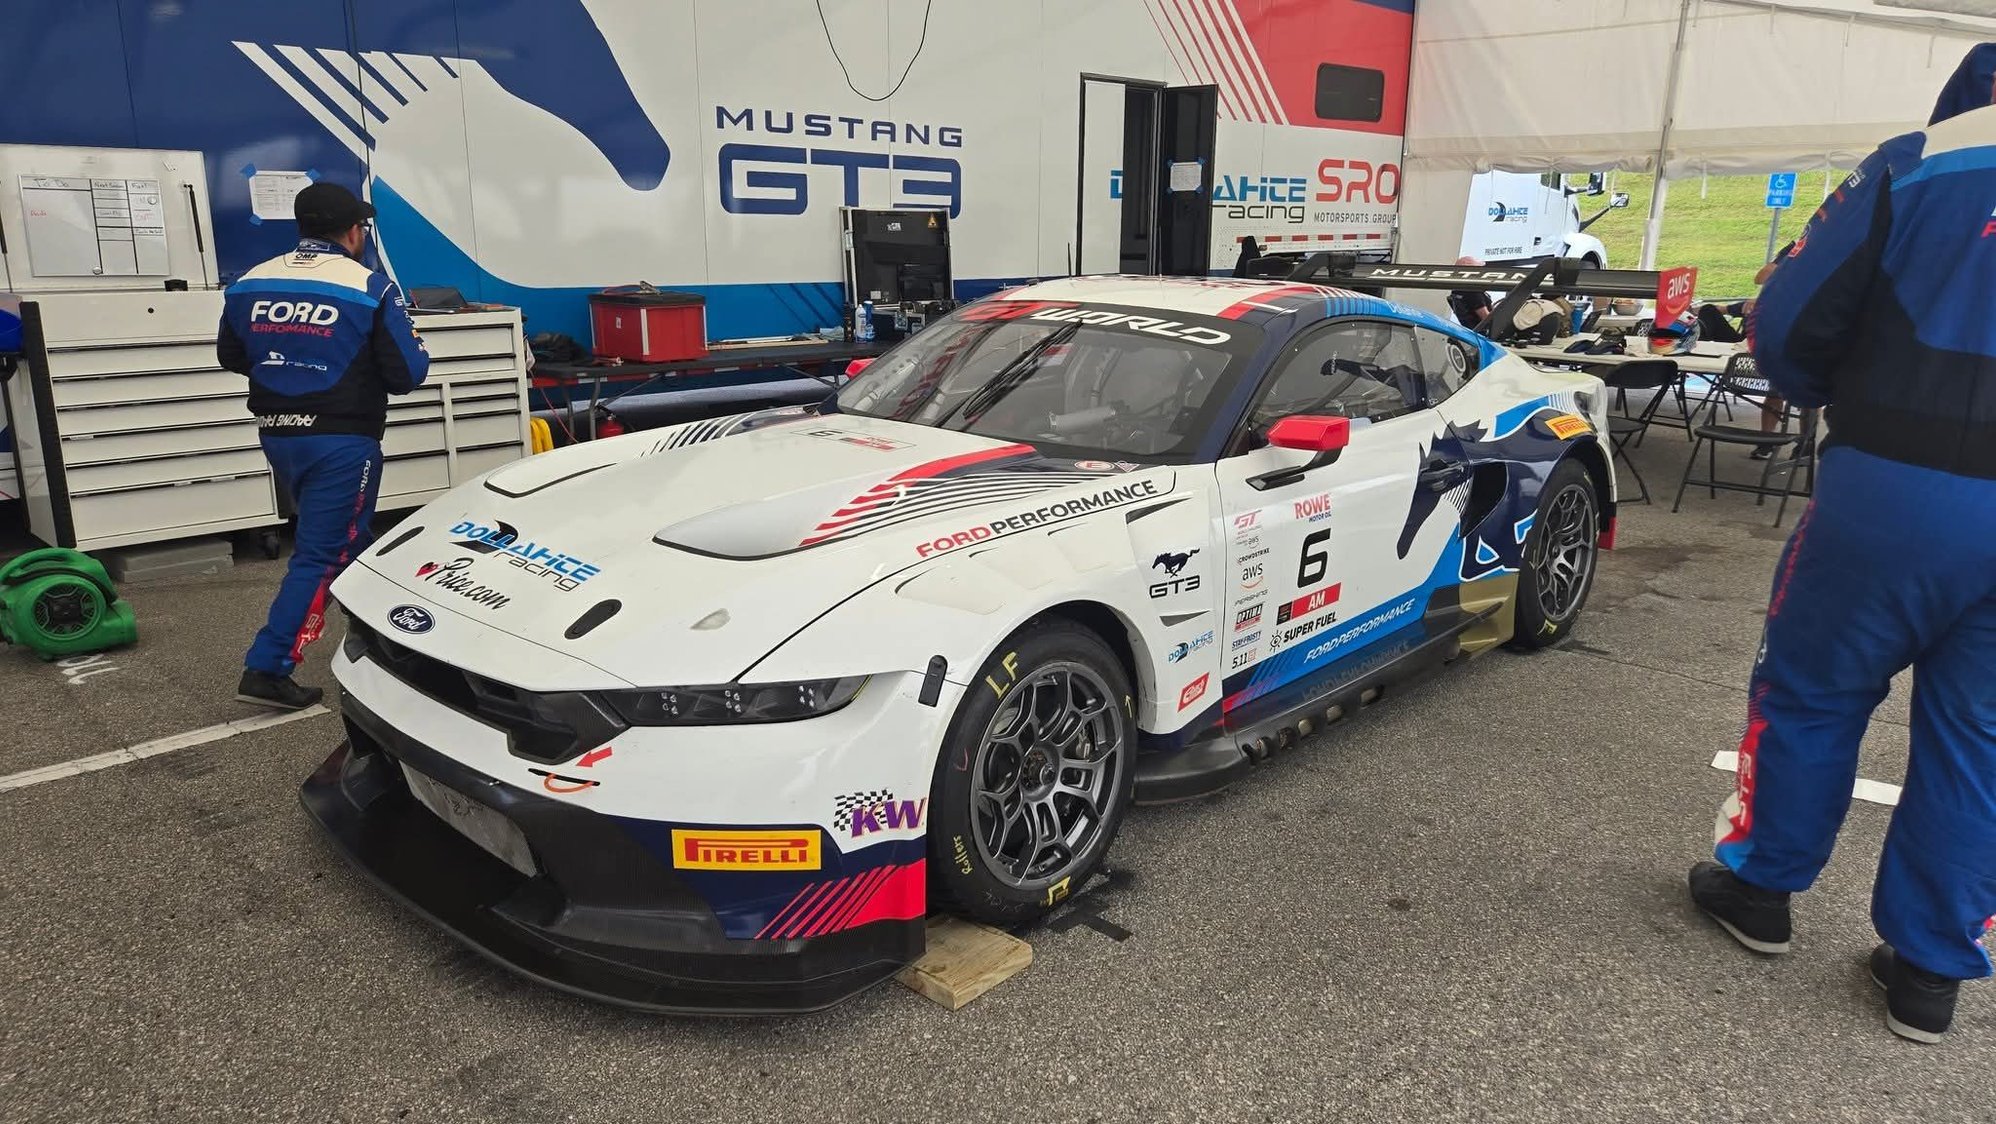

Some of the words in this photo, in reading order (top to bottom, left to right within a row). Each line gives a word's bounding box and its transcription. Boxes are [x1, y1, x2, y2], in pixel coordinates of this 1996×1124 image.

[716, 106, 962, 148] MUSTANG
[719, 143, 962, 219] GT3
[1316, 158, 1400, 205] SRO
[1314, 212, 1370, 223] MOTORSPORTS
[1372, 214, 1398, 225] GROUP
[295, 253, 318, 262] OMP
[1667, 273, 1690, 299] aws
[251, 300, 339, 325] FORD
[1030, 308, 1232, 345] WORLD
[276, 413, 317, 428] RACING
[1552, 418, 1587, 434] PIRELLI
[1294, 494, 1332, 519] ROWE
[1308, 513, 1322, 523] MOTOR
[1239, 547, 1270, 562] CROWDSTRIKE
[1297, 528, 1332, 588] 6
[493, 551, 580, 593] racing
[1242, 563, 1263, 581] aws
[1150, 575, 1200, 599] GT3
[1308, 590, 1326, 610] AM
[393, 608, 426, 631] Ford
[1283, 620, 1314, 643] SUPER
[1315, 612, 1337, 631] FUEL
[985, 651, 1018, 700] LF
[850, 796, 928, 838] KW
[685, 837, 809, 863] PIRELLI
